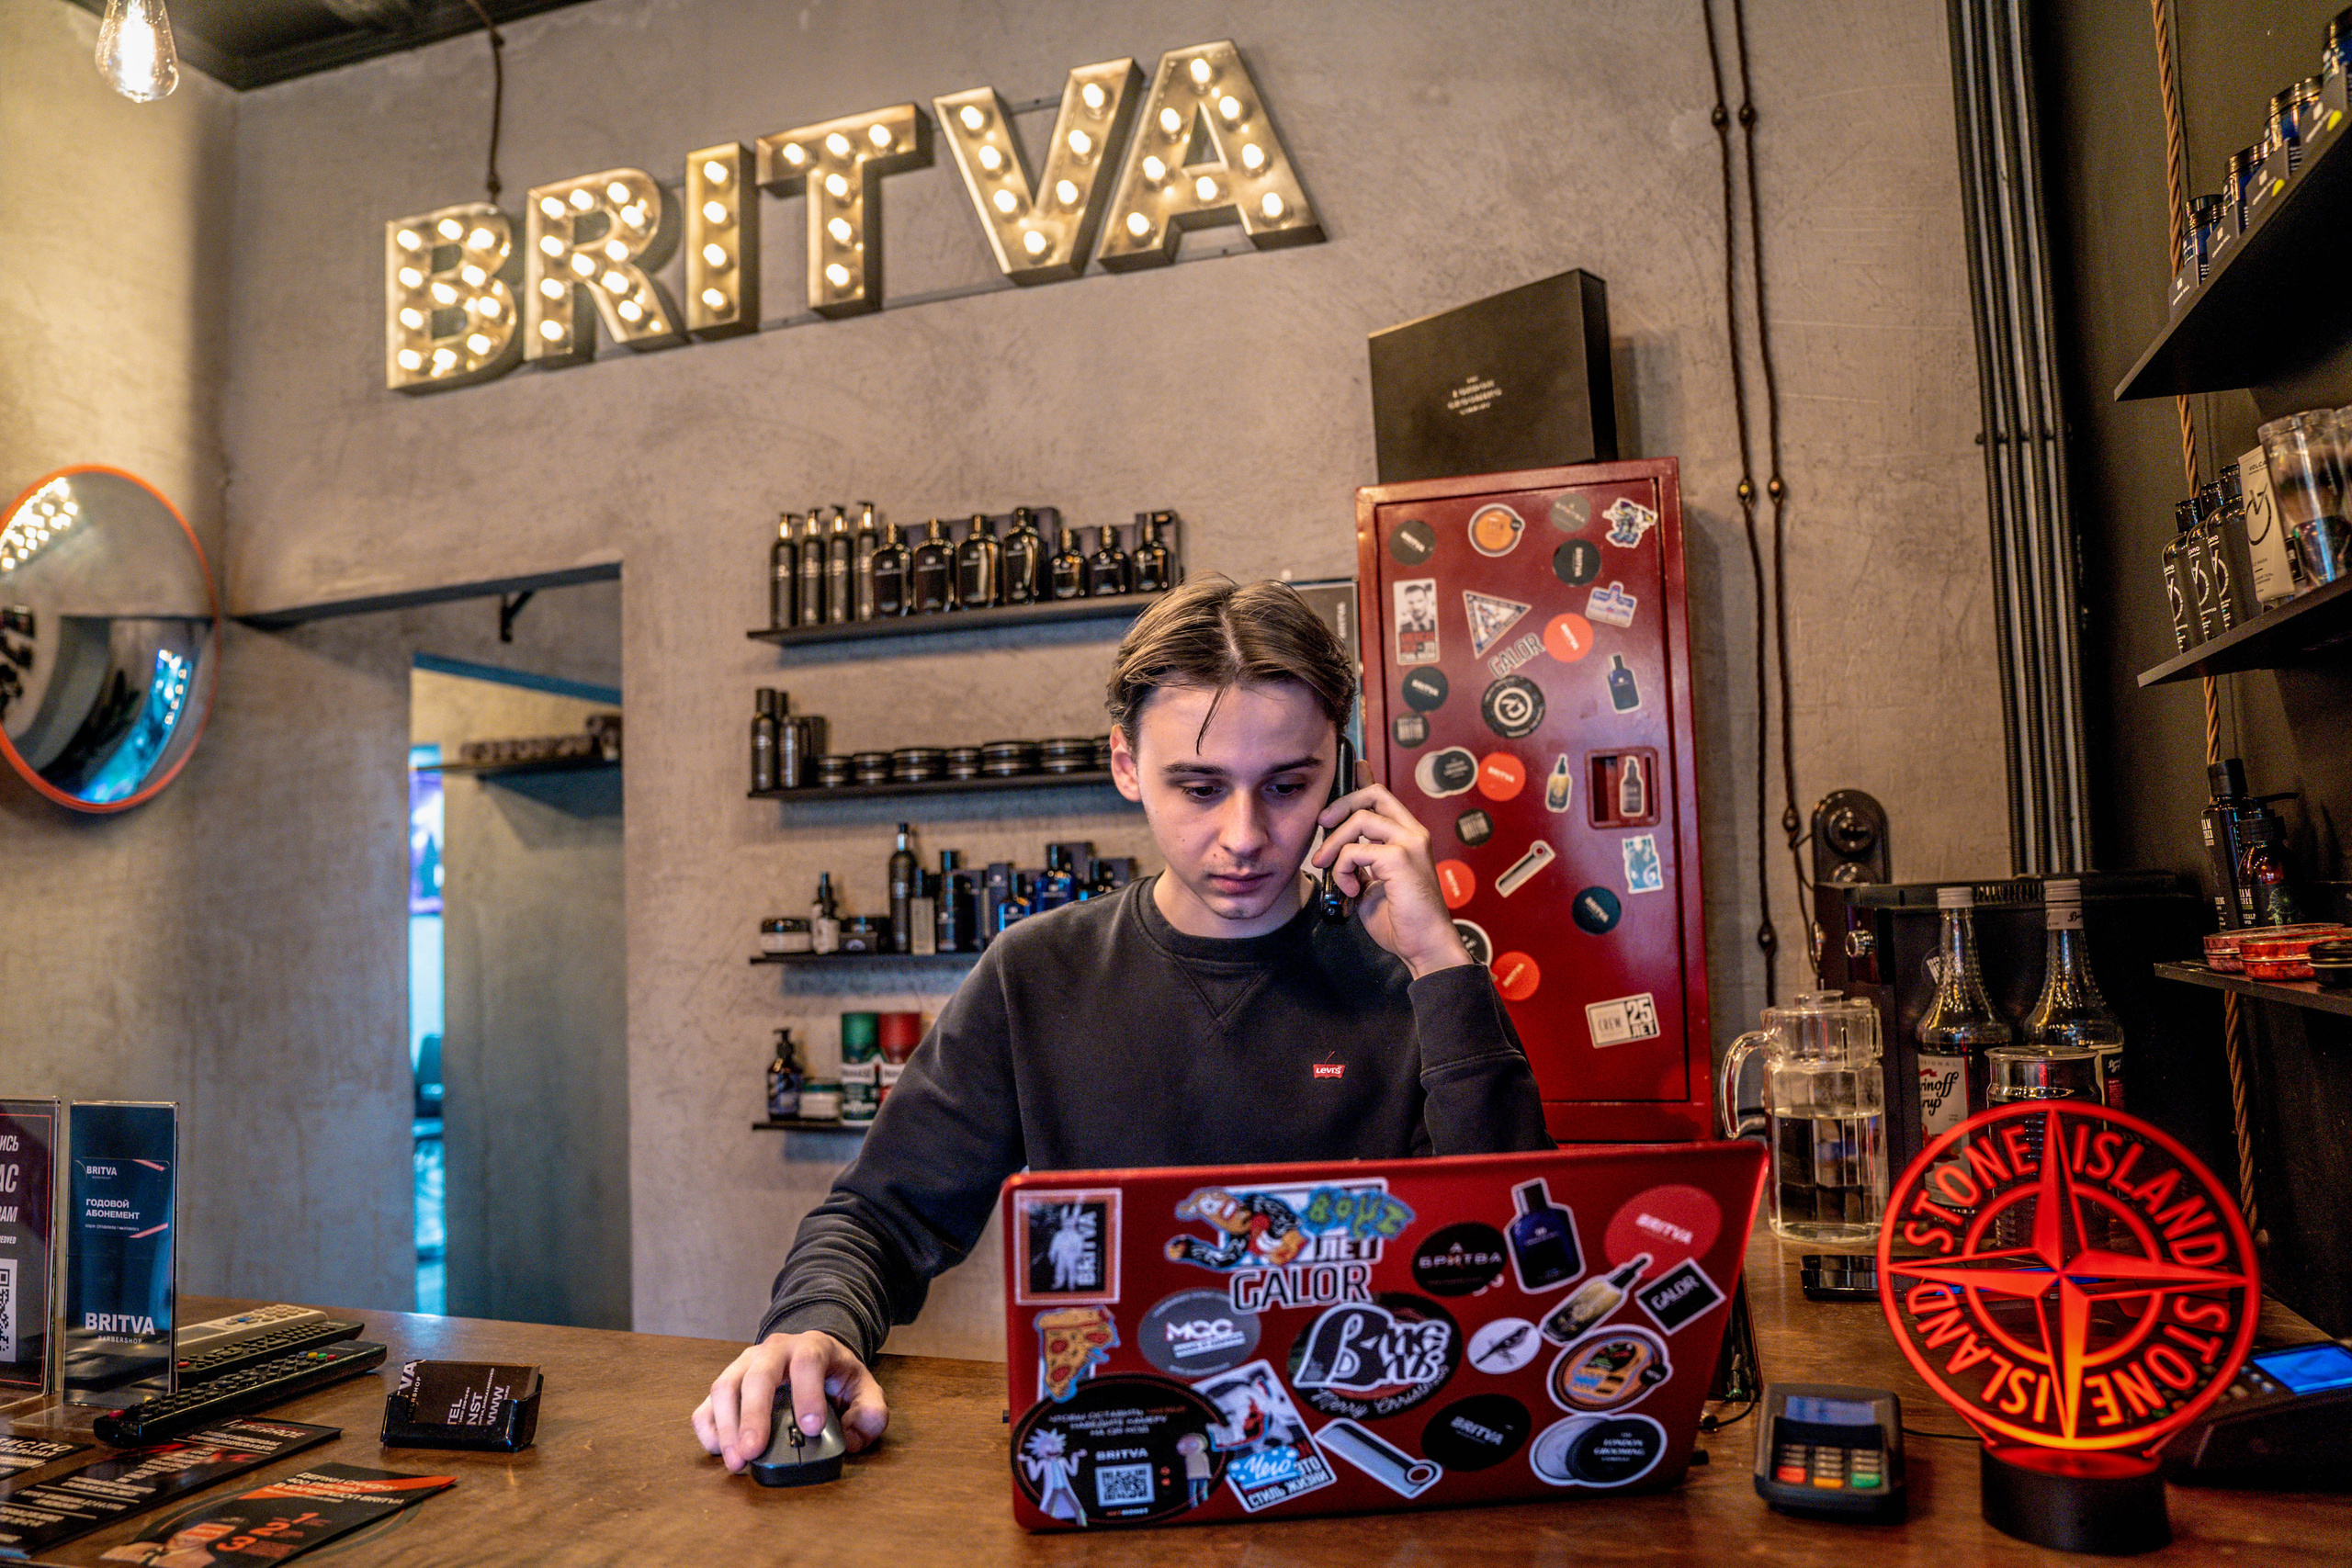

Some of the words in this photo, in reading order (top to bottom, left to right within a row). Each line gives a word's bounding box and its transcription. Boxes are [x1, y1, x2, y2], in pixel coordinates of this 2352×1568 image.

[386, 39, 1326, 389] BRITVA
[1488, 632, 1546, 680] GALOR
[1625, 998, 1654, 1025] 25
[86, 1165, 118, 1176] BRITVA
[1903, 1124, 2039, 1254] STONE
[2071, 1123, 2229, 1267] ISLAND
[85, 1198, 130, 1209] ГОДОВОЙ
[85, 1209, 140, 1220] АБОНЕМЕНТ
[1231, 1262, 1372, 1314] GALOR
[1650, 1274, 1701, 1311] GALOR
[85, 1312, 156, 1336] BRITVA
[97, 1335, 142, 1345] BARBERSHOP
[1905, 1281, 2052, 1424] ISLAND
[2083, 1294, 2231, 1427] STONE
[1450, 1416, 1505, 1446] BRITVA
[1094, 1447, 1149, 1461] BRITVA
[249, 1521, 291, 1537] 2
[291, 1512, 320, 1524] 1
[216, 1535, 257, 1551] 3
